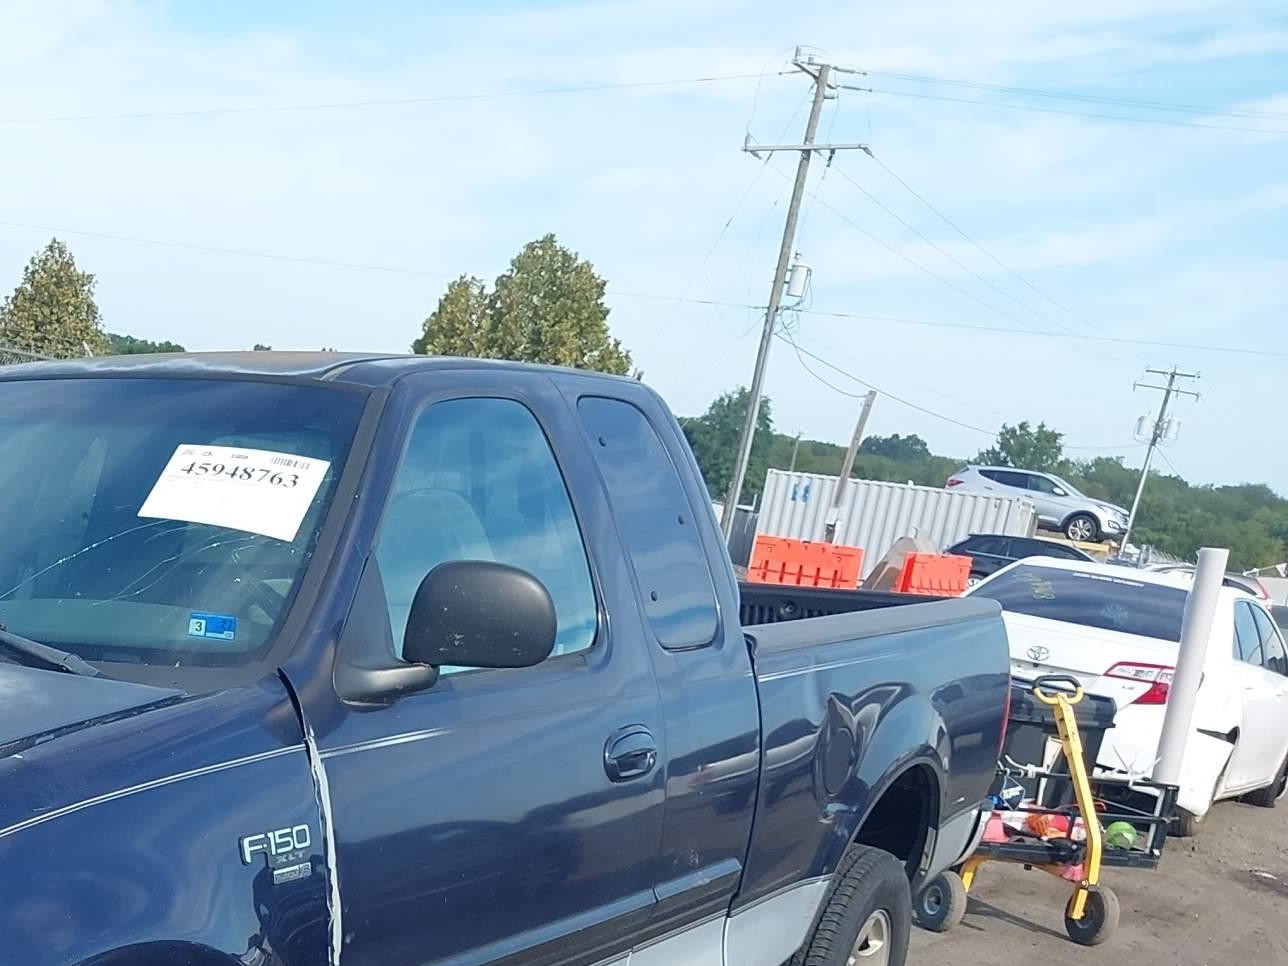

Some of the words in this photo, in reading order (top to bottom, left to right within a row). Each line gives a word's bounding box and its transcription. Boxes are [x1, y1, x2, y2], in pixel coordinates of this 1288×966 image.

[180, 461, 300, 489] 45948763
[195, 621, 203, 632] 3
[275, 849, 307, 864] XLT
